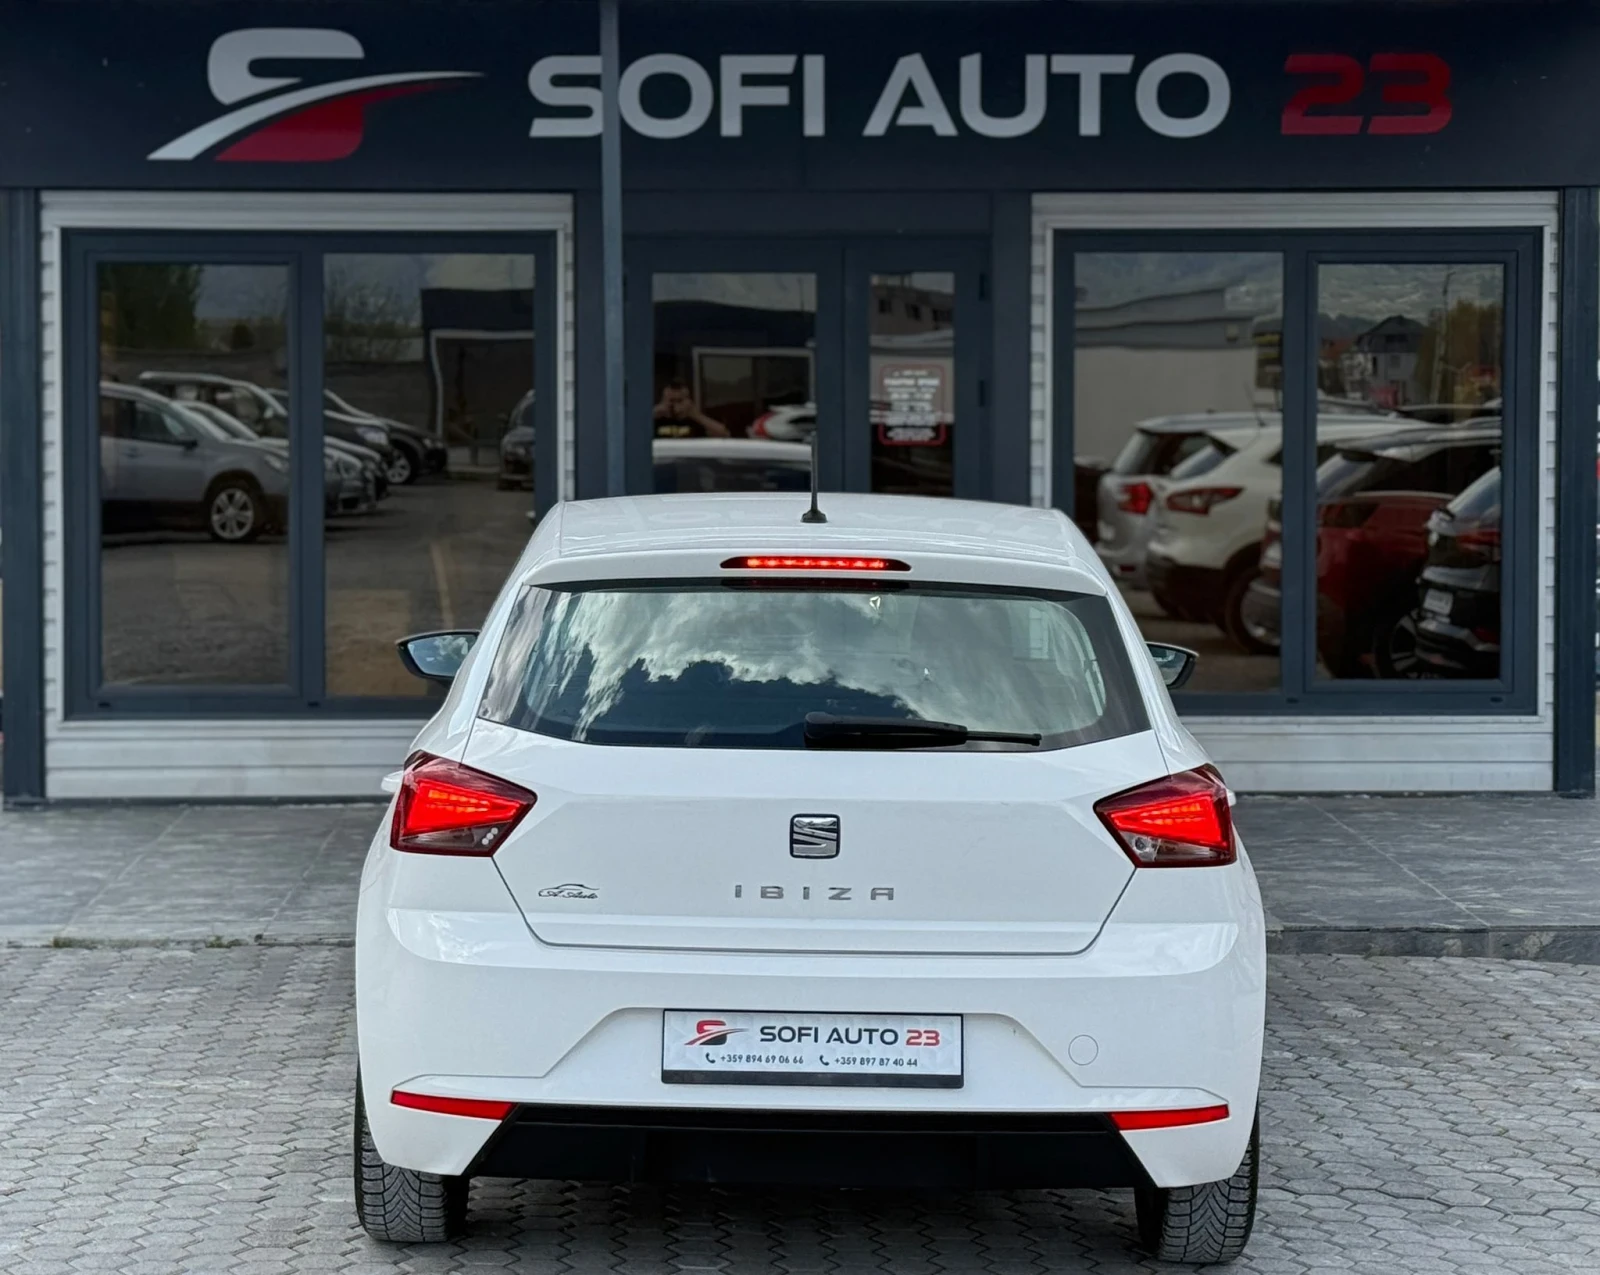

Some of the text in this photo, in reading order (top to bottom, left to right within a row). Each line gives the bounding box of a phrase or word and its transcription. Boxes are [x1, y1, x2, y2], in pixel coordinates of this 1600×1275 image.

[527, 52, 1453, 139] SOFI AUTO 23
[734, 884, 895, 901] IBIZA
[759, 1025, 941, 1047] SOFI AUTO 23
[720, 1053, 804, 1065] +359 894 69 06 66
[834, 1056, 918, 1067] +359 897 87 40 44
